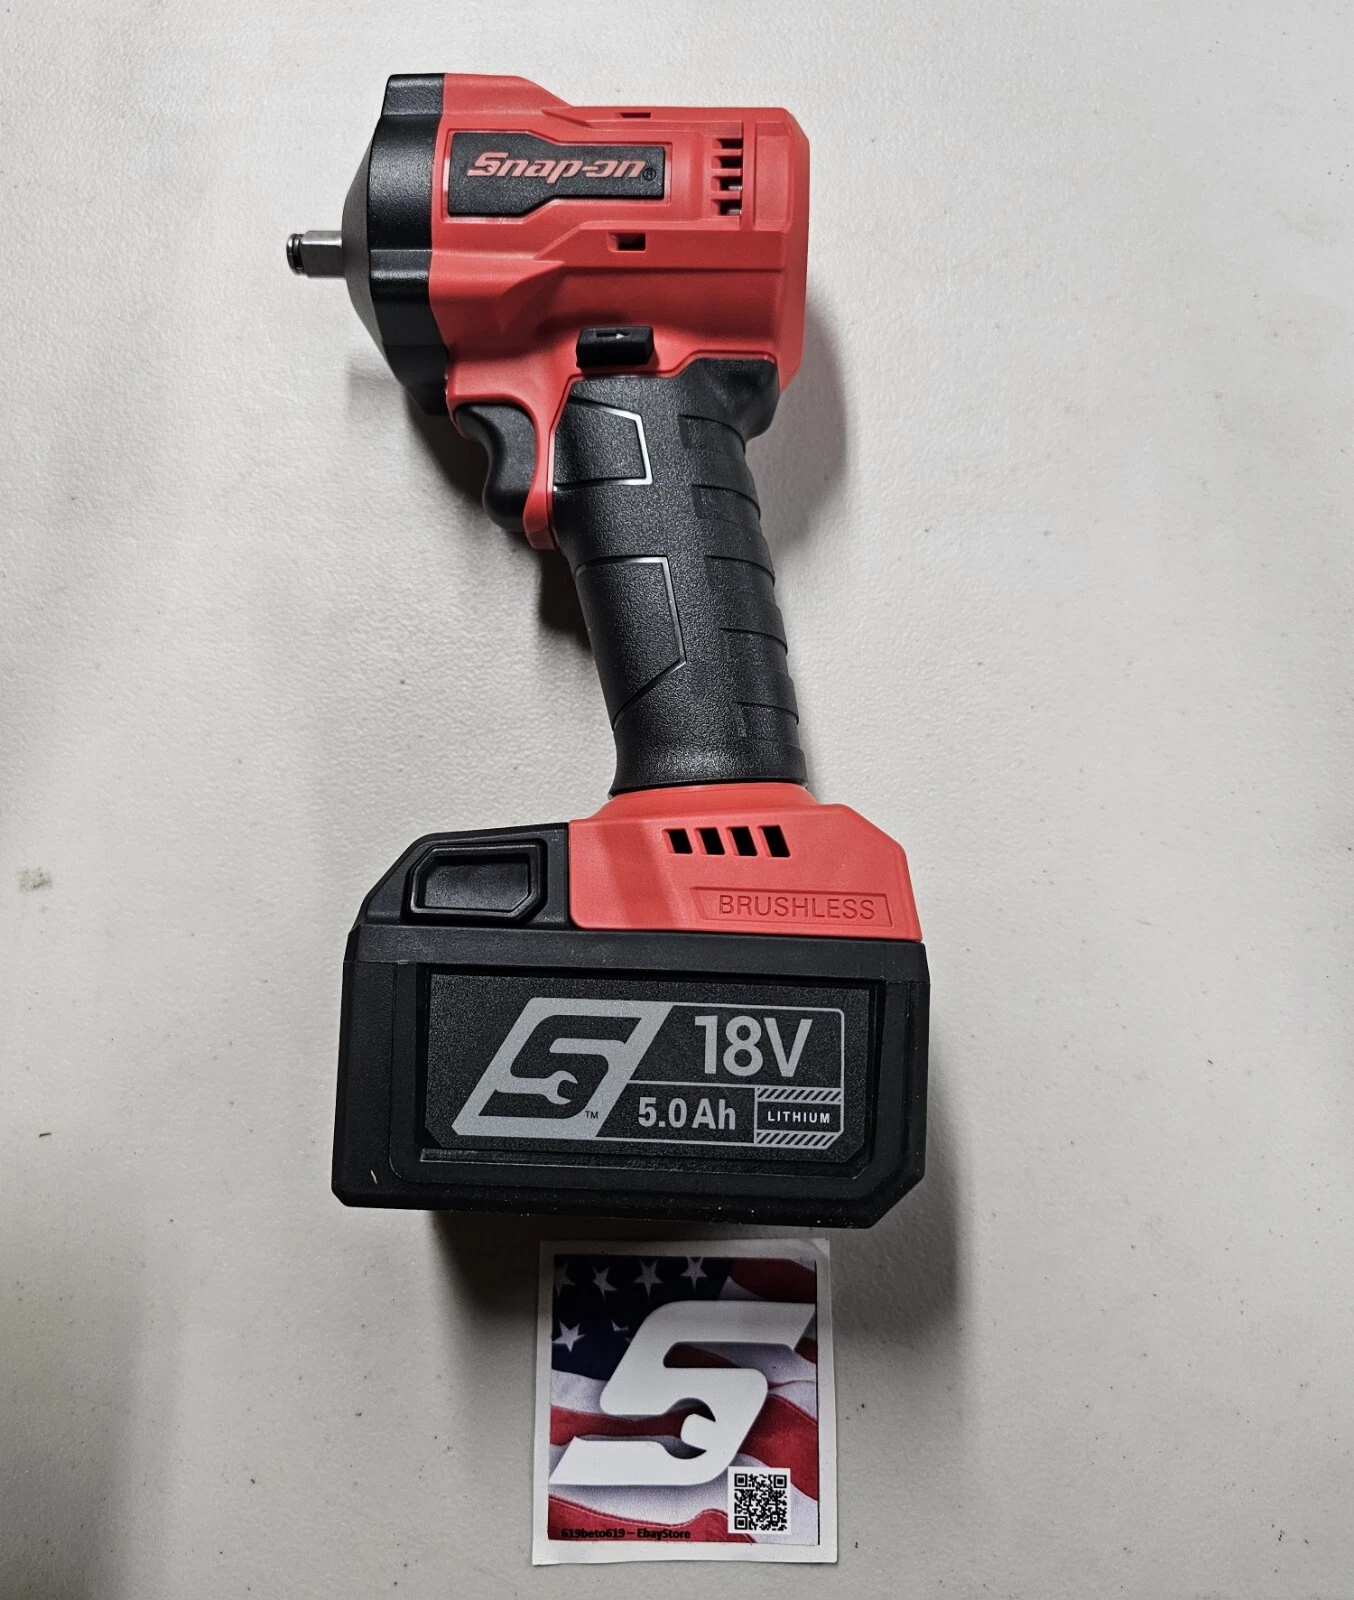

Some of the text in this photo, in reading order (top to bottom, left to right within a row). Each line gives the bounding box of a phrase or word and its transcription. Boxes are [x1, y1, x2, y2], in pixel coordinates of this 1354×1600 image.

[719, 895, 876, 920] BRUSHLESS
[694, 1015, 813, 1078] 18V
[767, 1110, 832, 1125] LITHIUM
[560, 1528, 626, 1540] 619beto619
[636, 1529, 691, 1541] EbayStore
